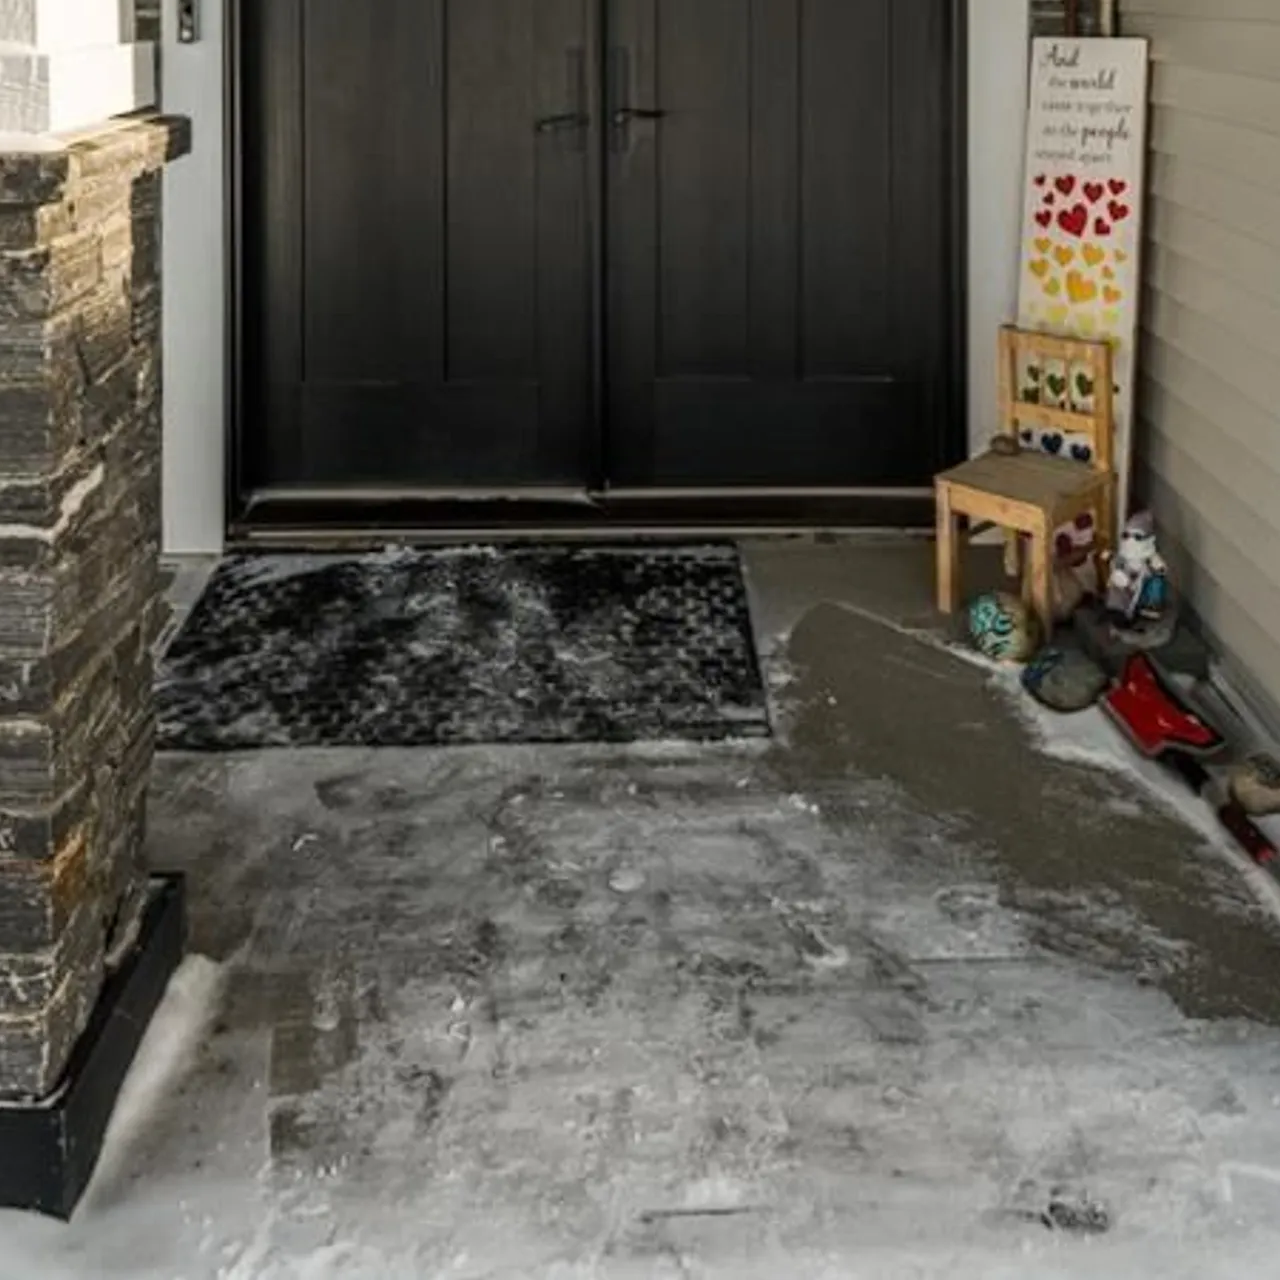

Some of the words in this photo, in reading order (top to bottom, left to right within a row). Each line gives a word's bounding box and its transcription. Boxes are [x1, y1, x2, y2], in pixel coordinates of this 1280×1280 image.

[1039, 44, 1080, 67] And
[1069, 69, 1116, 90] world
[1081, 116, 1129, 149] people
